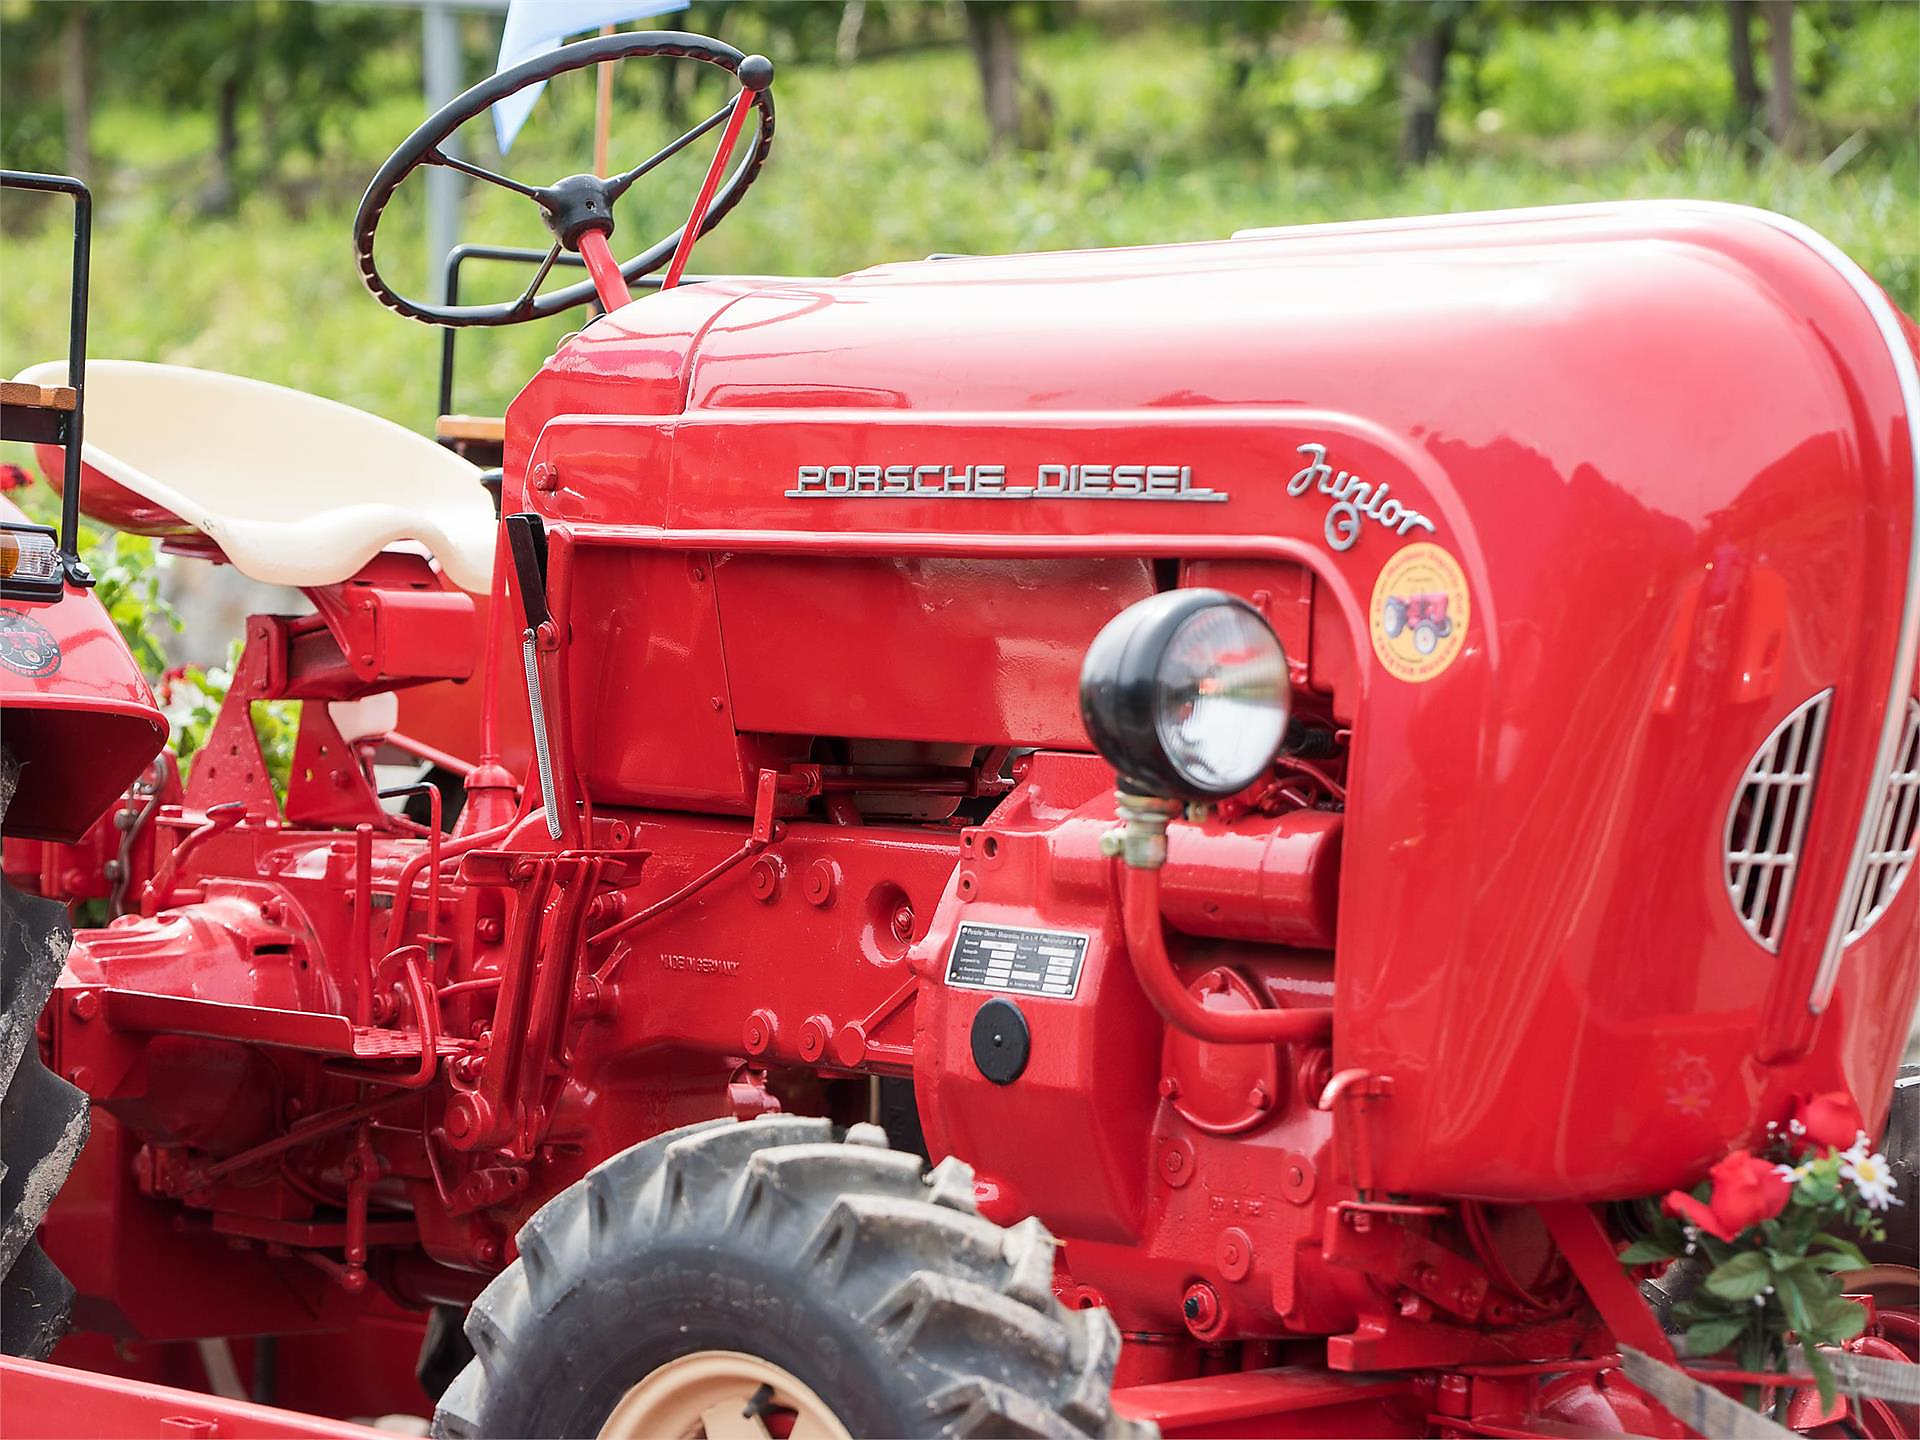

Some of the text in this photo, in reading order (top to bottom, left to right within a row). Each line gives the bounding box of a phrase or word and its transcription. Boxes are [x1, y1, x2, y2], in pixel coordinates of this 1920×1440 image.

[796, 464, 1206, 498] PORSCHE DIESEL
[1287, 443, 1435, 551] Junior
